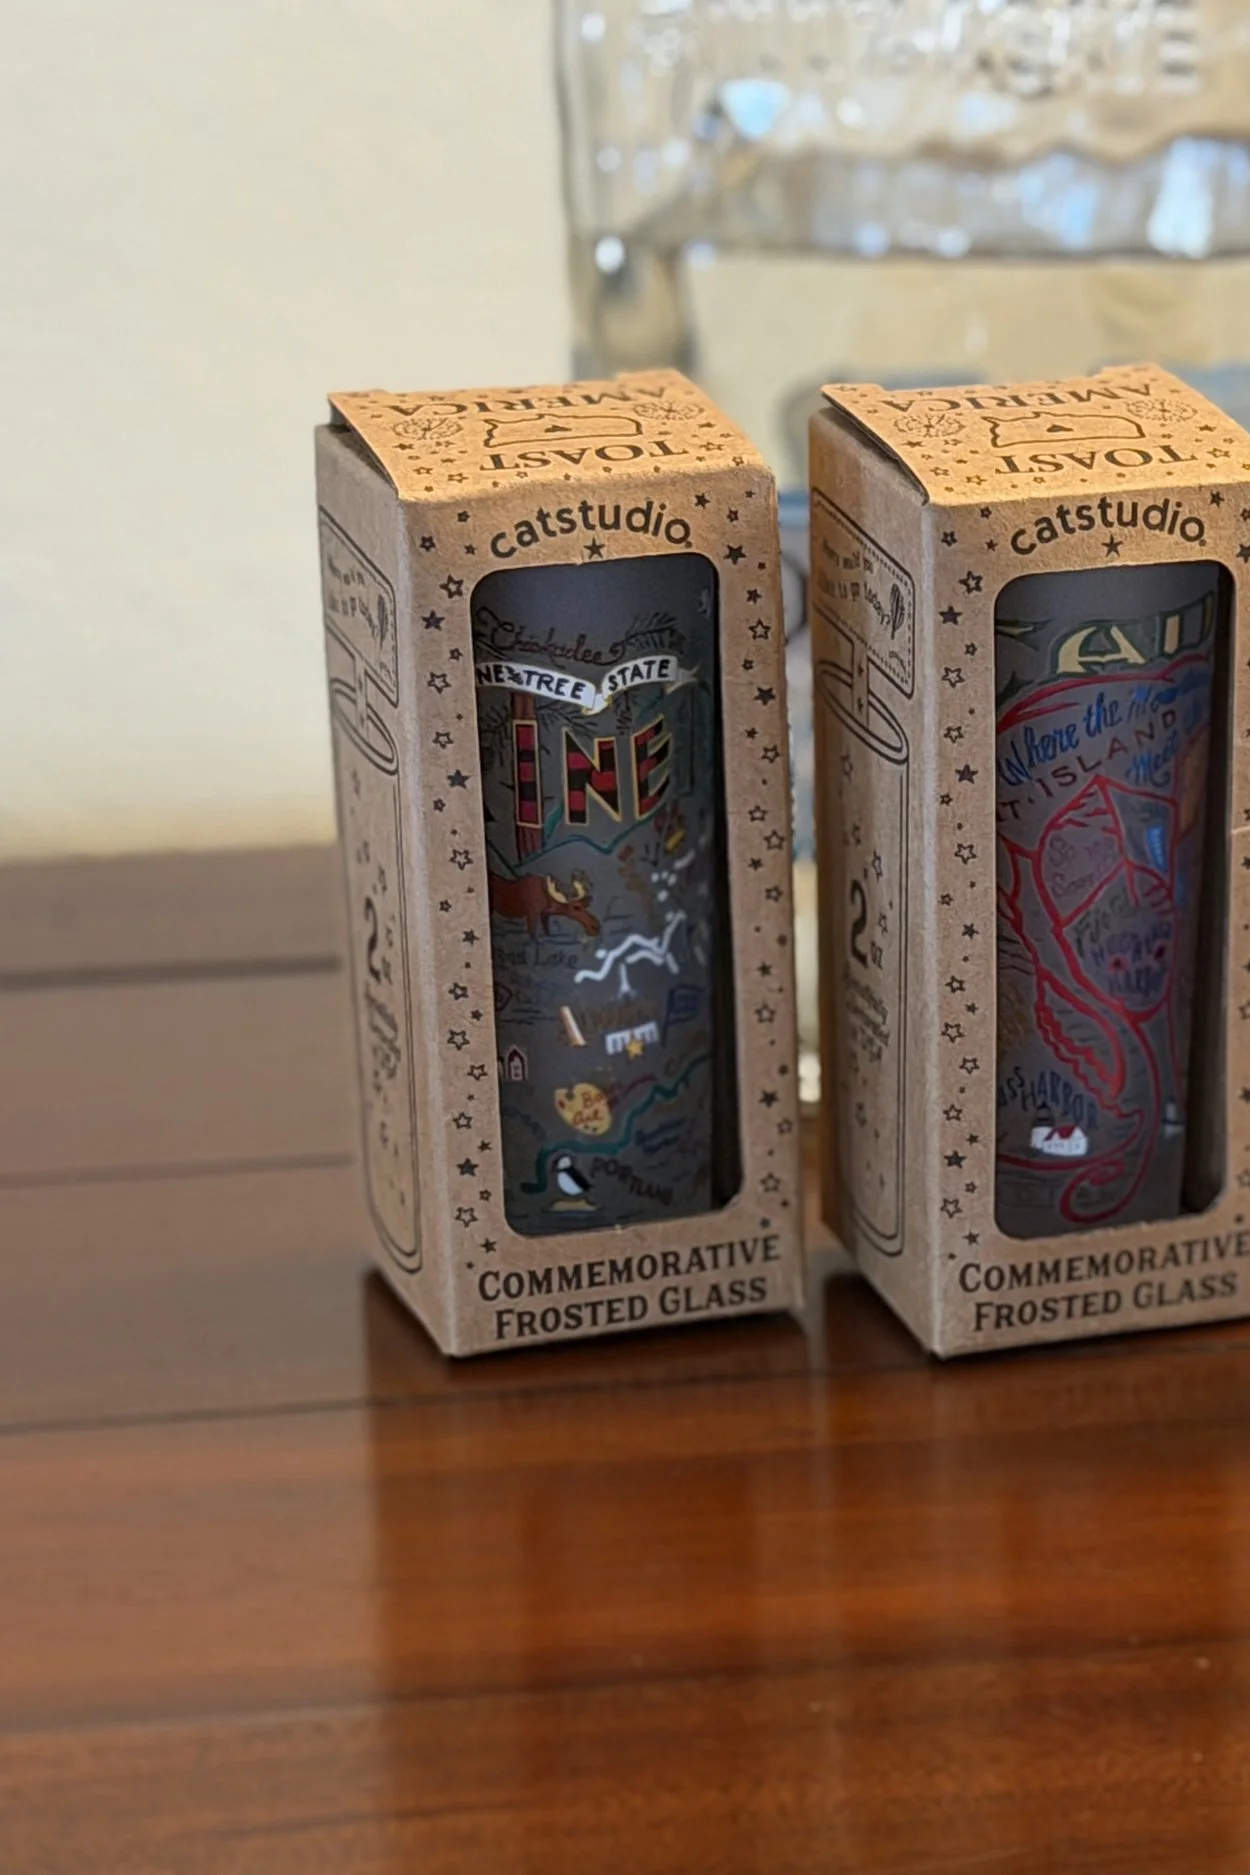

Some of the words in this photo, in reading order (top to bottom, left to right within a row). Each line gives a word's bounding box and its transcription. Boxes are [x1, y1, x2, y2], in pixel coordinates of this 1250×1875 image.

[388, 385, 668, 417] AMERICA
[883, 383, 1154, 413] AMERICA
[479, 439, 690, 472] TOAST
[995, 444, 1196, 475] TOAST
[490, 499, 690, 559] catstudio
[1010, 497, 1205, 556] catstudio
[520, 670, 588, 700] TREE
[608, 658, 671, 692] STATE
[998, 721, 1080, 787] Where
[1085, 692, 1121, 738] the
[1035, 709, 1177, 797] ISLAND
[850, 879, 868, 969] 2
[478, 1235, 781, 1302] COMMEMORATIVE
[496, 1295, 648, 1341] FROSTED
[659, 1277, 767, 1317] GLASS
[974, 1290, 1122, 1332] FROSTED
[1132, 1273, 1239, 1309] GLASS
